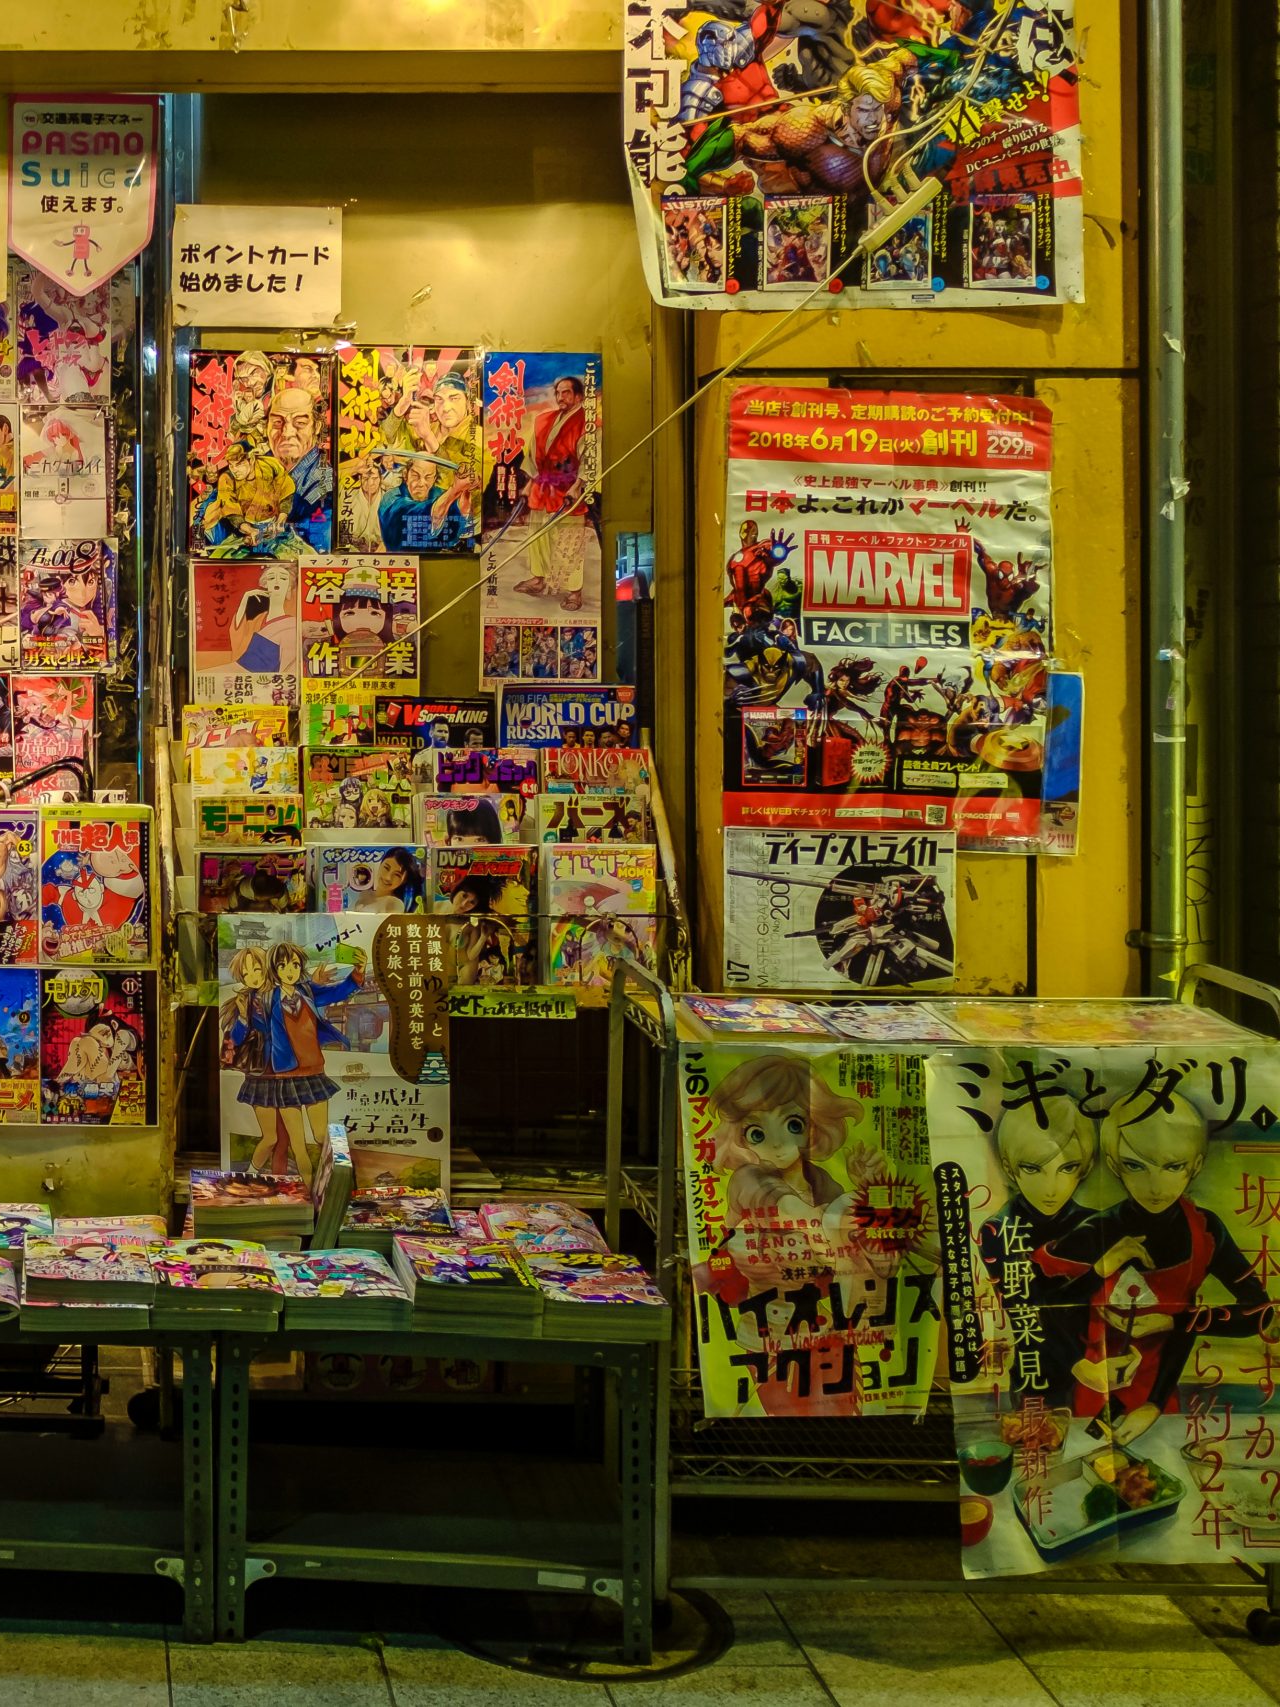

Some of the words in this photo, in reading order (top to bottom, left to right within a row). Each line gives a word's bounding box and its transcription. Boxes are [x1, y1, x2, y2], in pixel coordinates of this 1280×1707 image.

[22, 130, 145, 157] PASMO
[21, 160, 143, 188] Suica
[41, 194, 124, 213] 使えます。
[180, 244, 331, 266] ポイントカード
[308, 556, 412, 567] マンガでわかる
[812, 549, 963, 609] MARVEL
[811, 621, 881, 646] FACT
[890, 622, 963, 647] FILES
[505, 702, 586, 727] WORLD
[590, 703, 636, 727] CUP
[506, 725, 562, 741] RUSSIA
[996, 1215, 1050, 1394] 佐野菜見
